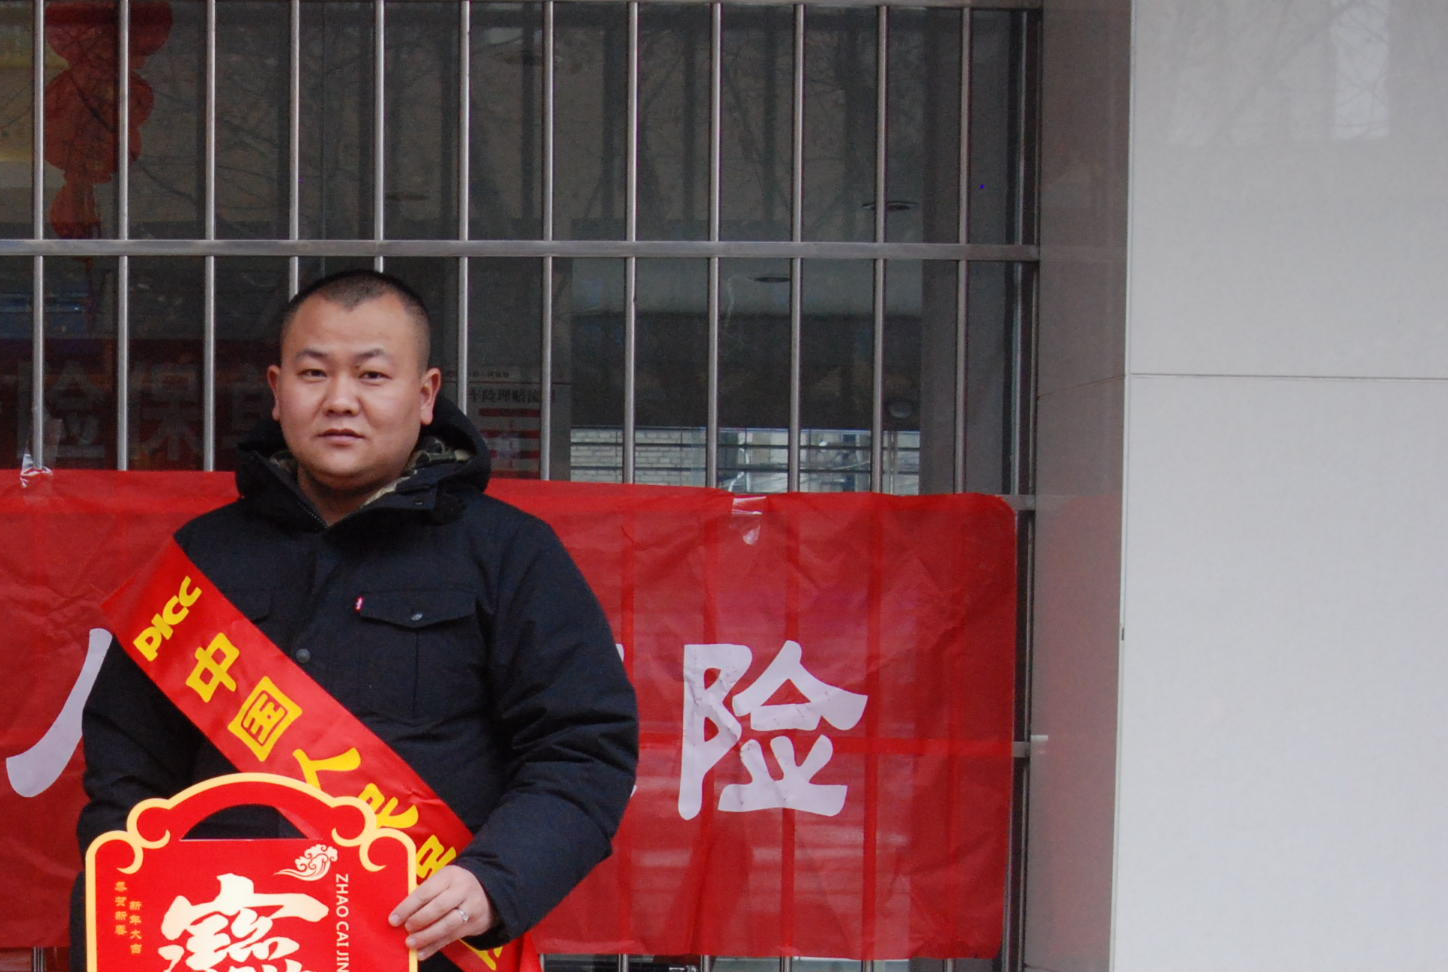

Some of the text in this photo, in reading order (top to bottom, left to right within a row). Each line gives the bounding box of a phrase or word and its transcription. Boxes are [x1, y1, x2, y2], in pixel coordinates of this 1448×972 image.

[133, 576, 202, 662] PICC
[336, 873, 350, 918] ZHAO
[336, 920, 350, 947] CAI
